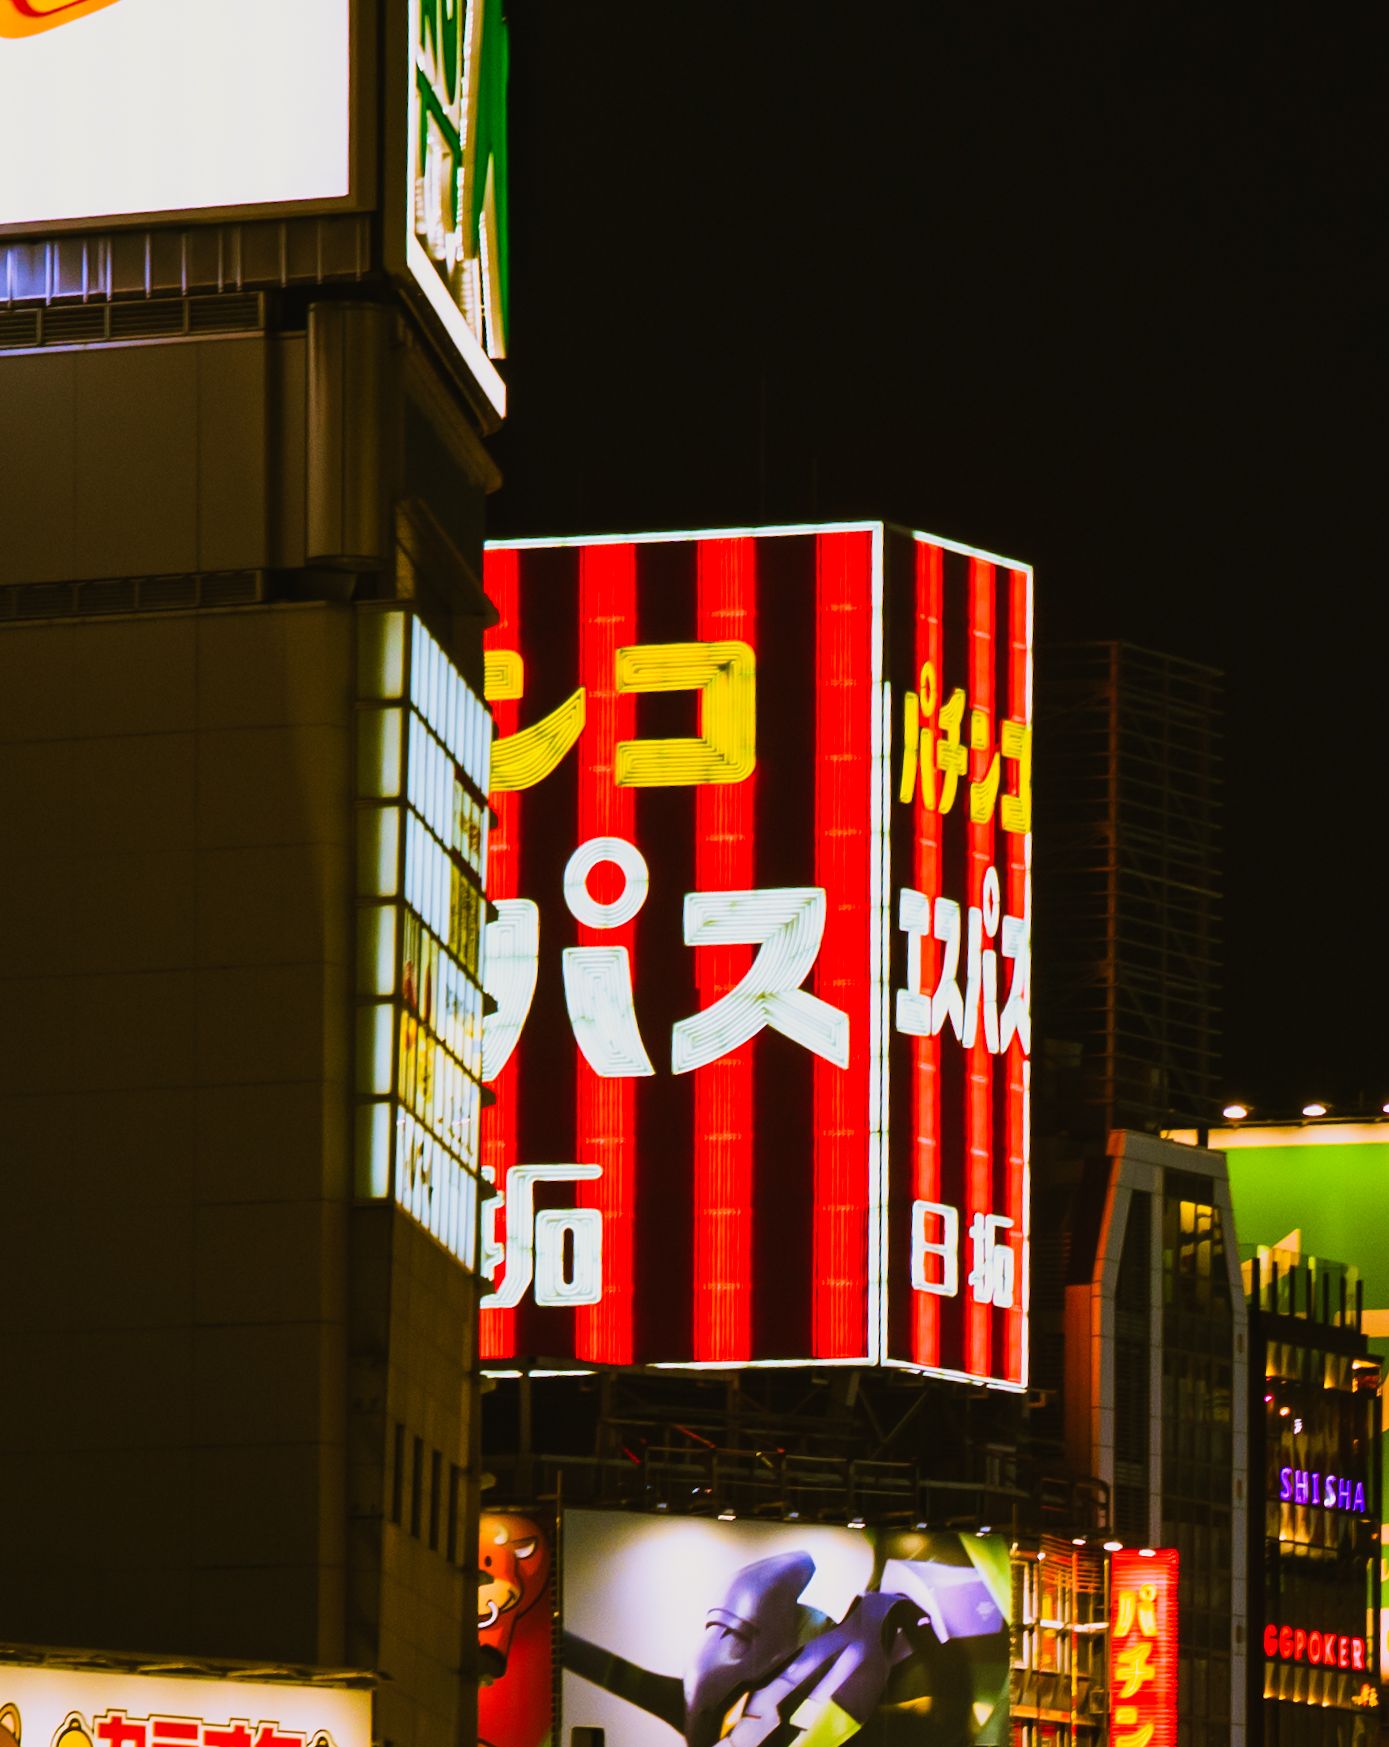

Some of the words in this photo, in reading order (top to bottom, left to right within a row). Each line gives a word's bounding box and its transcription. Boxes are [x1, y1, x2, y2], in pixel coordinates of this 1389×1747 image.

[899, 661, 1030, 833] パチンコ
[896, 866, 1030, 1055] エスパス
[910, 1200, 1014, 1307] 日拓
[1279, 1467, 1366, 1512] SHISHA
[1264, 1623, 1365, 1672] GGPOKER
